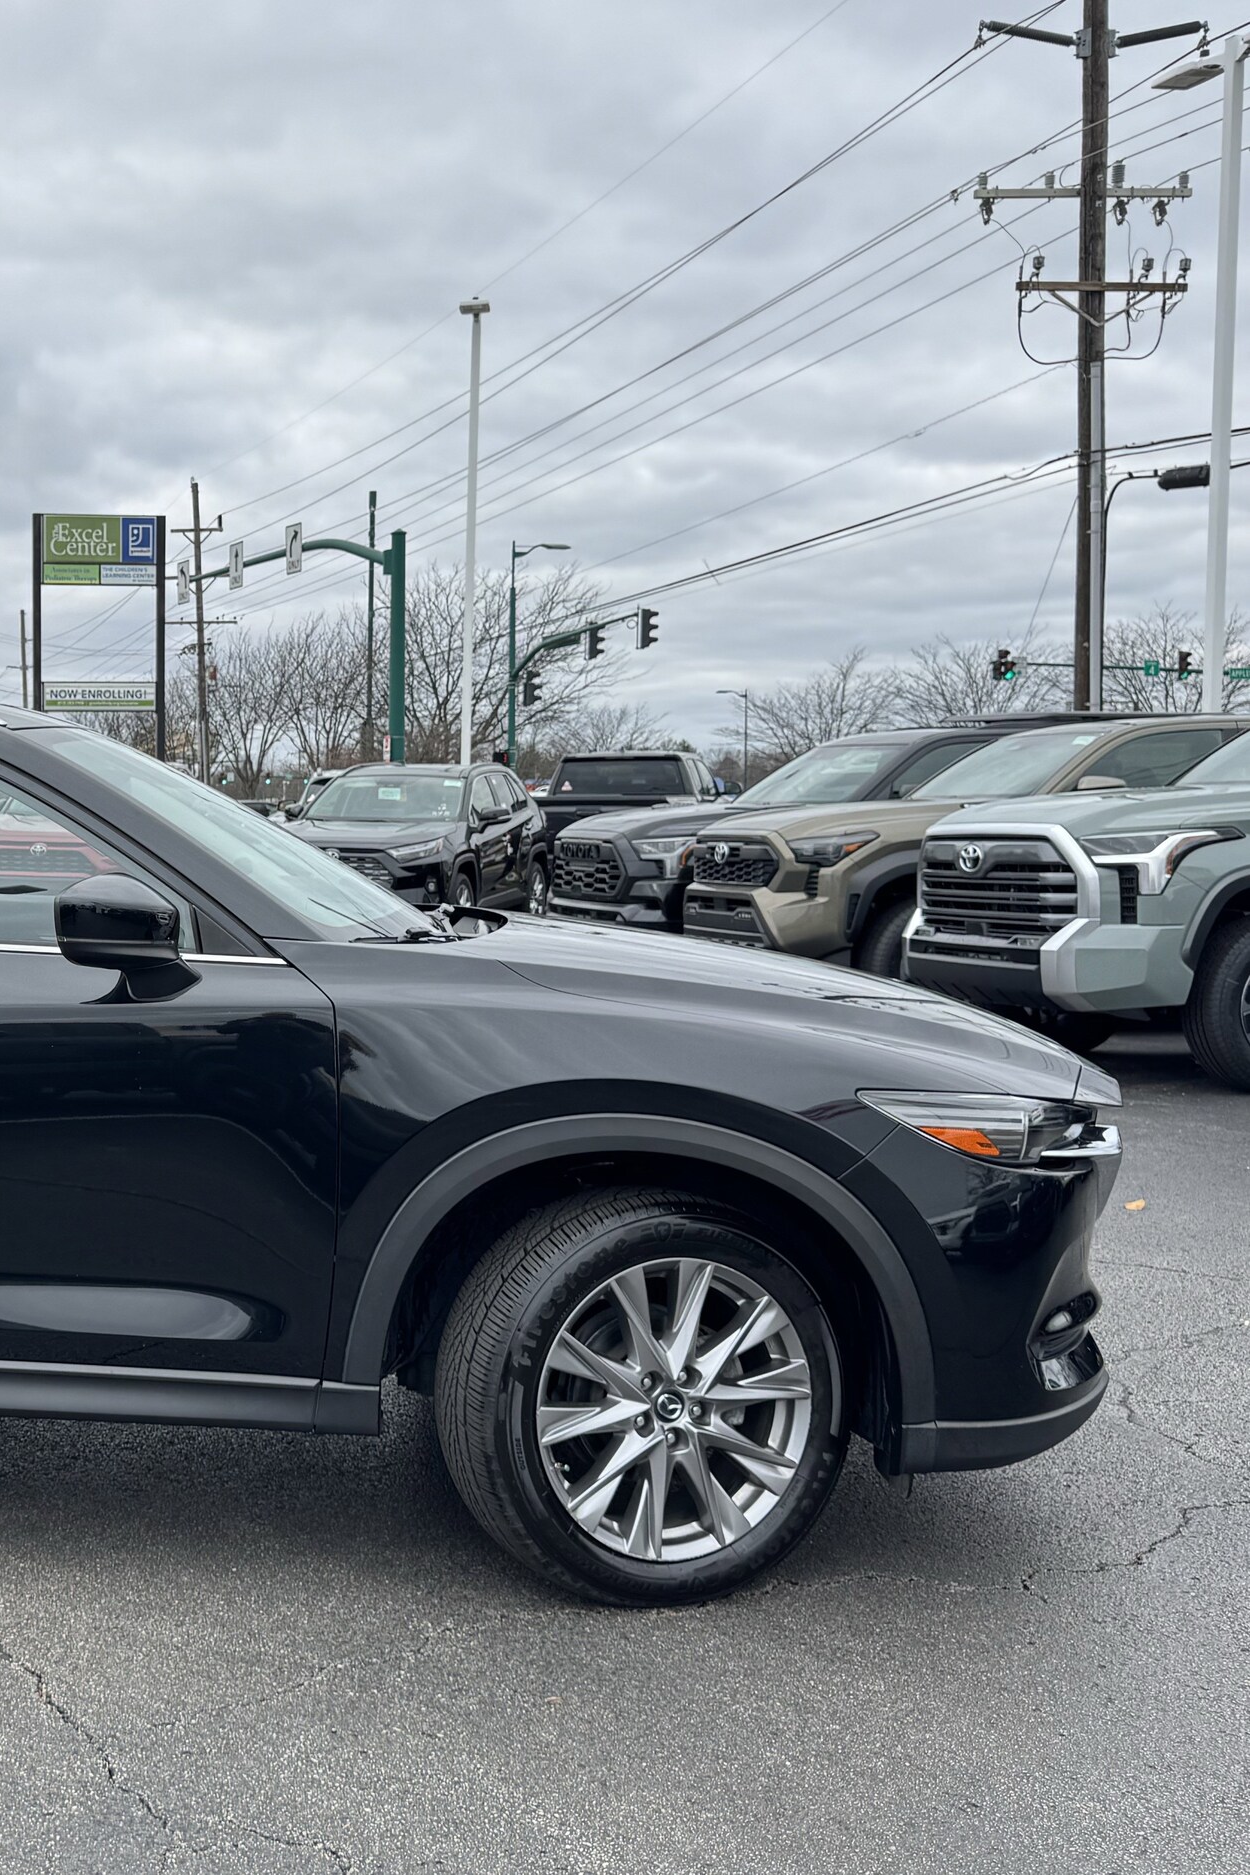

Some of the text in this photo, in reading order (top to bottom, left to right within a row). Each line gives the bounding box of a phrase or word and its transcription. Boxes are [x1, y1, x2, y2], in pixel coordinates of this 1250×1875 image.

[58, 522, 108, 543] Excel
[50, 538, 116, 556] Center
[49, 689, 147, 700] NOW ENROLLING!
[562, 843, 597, 860] TOYOTA
[511, 1236, 630, 1369] Firestone
[514, 1437, 527, 1471] OUTSIDE
